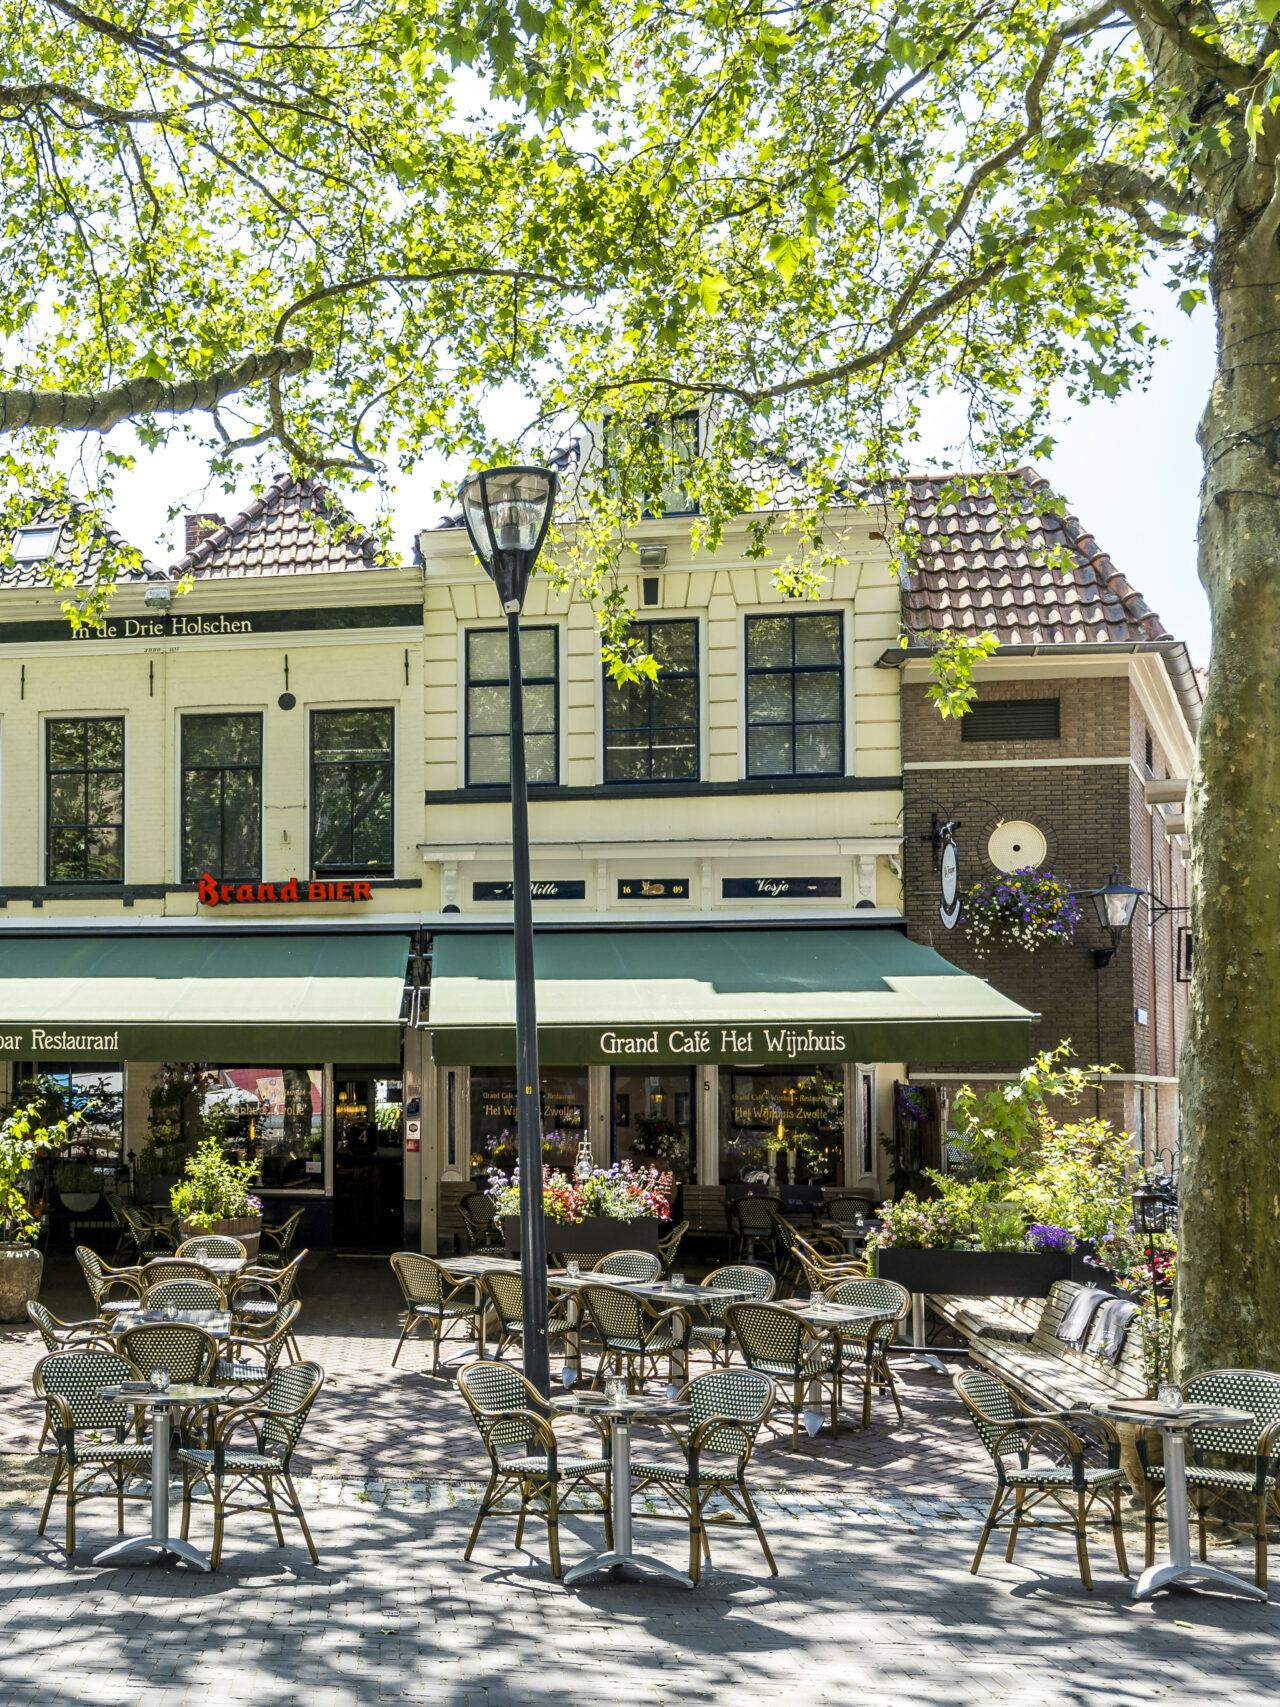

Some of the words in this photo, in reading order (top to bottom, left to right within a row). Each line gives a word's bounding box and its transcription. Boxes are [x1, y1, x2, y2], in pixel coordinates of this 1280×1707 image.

[96, 622, 117, 638] de
[124, 619, 163, 637] Drie
[171, 615, 252, 635] Holschen
[198, 871, 299, 907] Brand
[308, 881, 373, 901] BIER
[622, 885, 631, 894] 16
[672, 885, 683, 894] 09
[755, 879, 789, 896] Vosje
[31, 1029, 119, 1050] Restaurant
[600, 1031, 659, 1054] Grand
[668, 1030, 711, 1053] Café
[720, 1030, 753, 1052] Het
[763, 1029, 846, 1058] Wijnhuis
[704, 1081, 710, 1091] 5
[358, 1130, 368, 1143] 4
